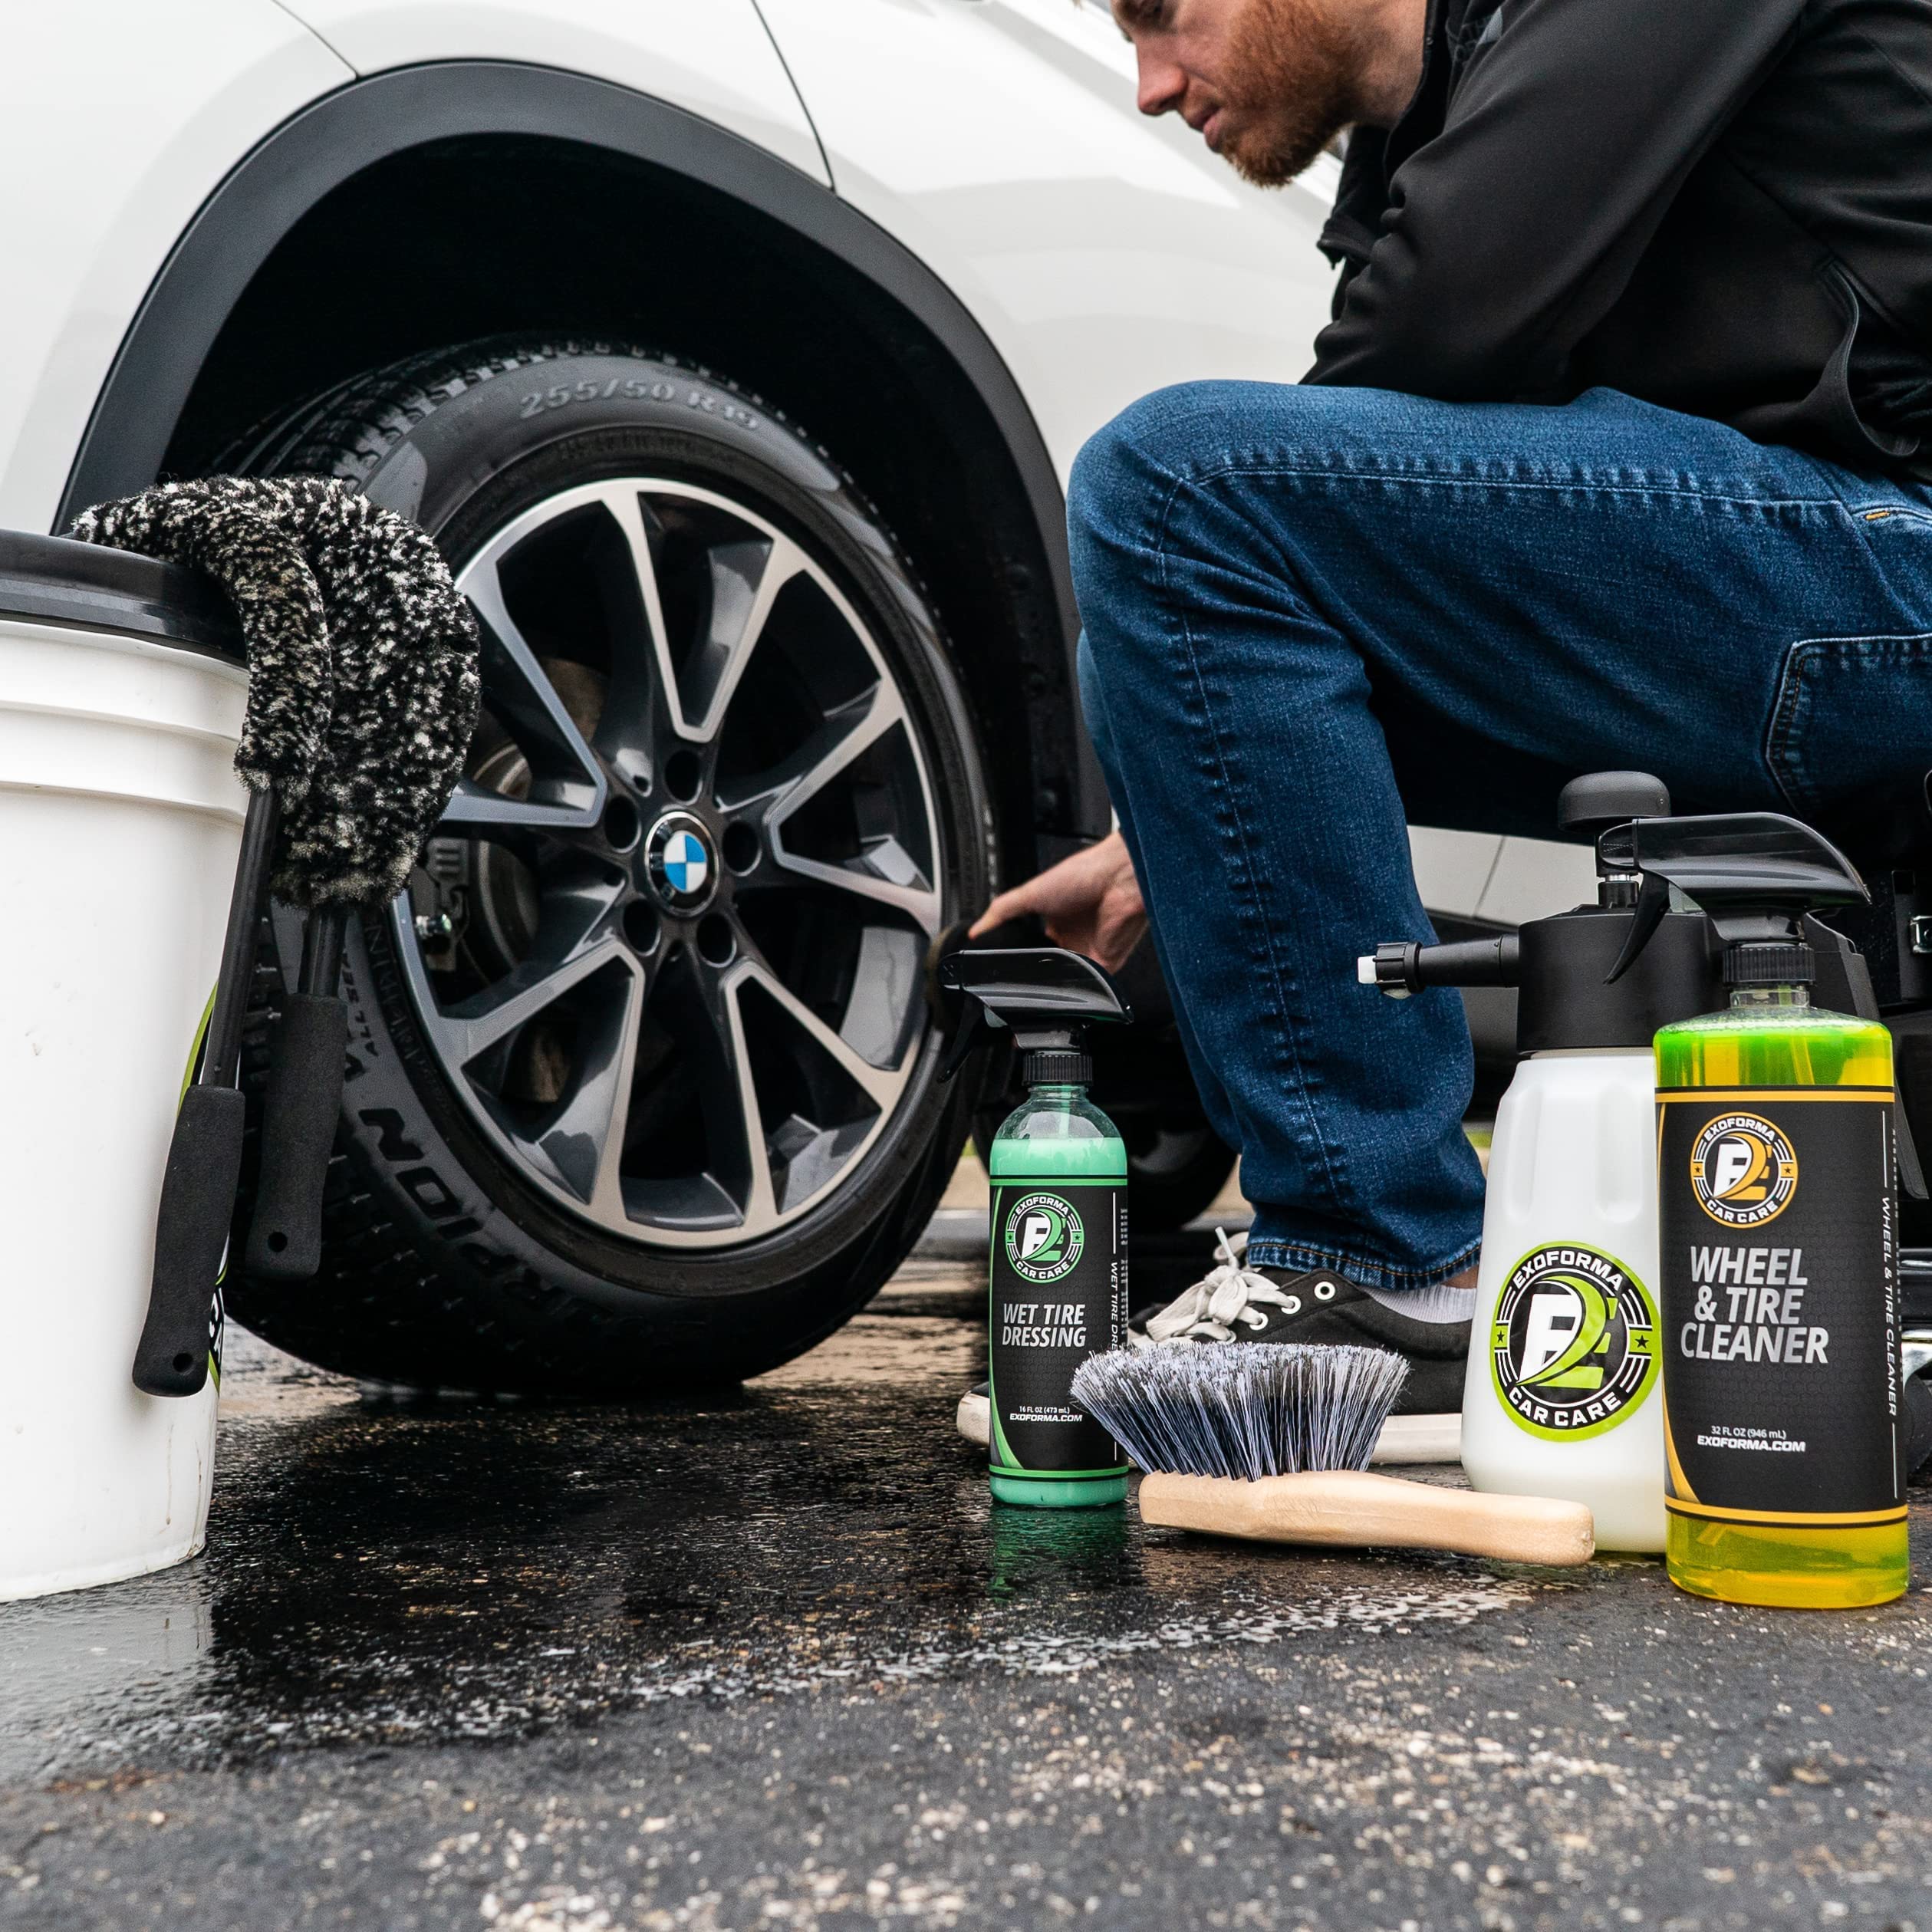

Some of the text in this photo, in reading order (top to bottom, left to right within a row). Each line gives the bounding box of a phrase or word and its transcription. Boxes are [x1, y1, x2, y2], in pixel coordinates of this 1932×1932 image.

[519, 378, 676, 419] 255/50
[1703, 1117, 1776, 1141] EXOFORMA
[1015, 1196, 1069, 1216] EXOFORMA
[1707, 1200, 1779, 1223] CAR CARE
[1015, 1260, 1070, 1279] CAR CARE
[1512, 1250, 1624, 1292] EXOFORMA
[1690, 1246, 1809, 1286] WHEEL
[1003, 1303, 1086, 1325] WET TIRE
[1693, 1285, 1804, 1325] & TIRE
[1882, 1196, 1897, 1417] WHEEL & TIRE CLEANER
[1002, 1325, 1087, 1348] DRESSING
[1680, 1322, 1829, 1364] CLEANER
[1009, 1413, 1083, 1422] EXOFORMA.COM
[1509, 1387, 1622, 1427] CAR CARE
[1697, 1434, 1806, 1453] EXOFORMA.COM
[1710, 1425, 1721, 1435] 32
[1722, 1427, 1732, 1436] FL
[1733, 1427, 1746, 1437] OZ
[1746, 1428, 1767, 1439] (946
